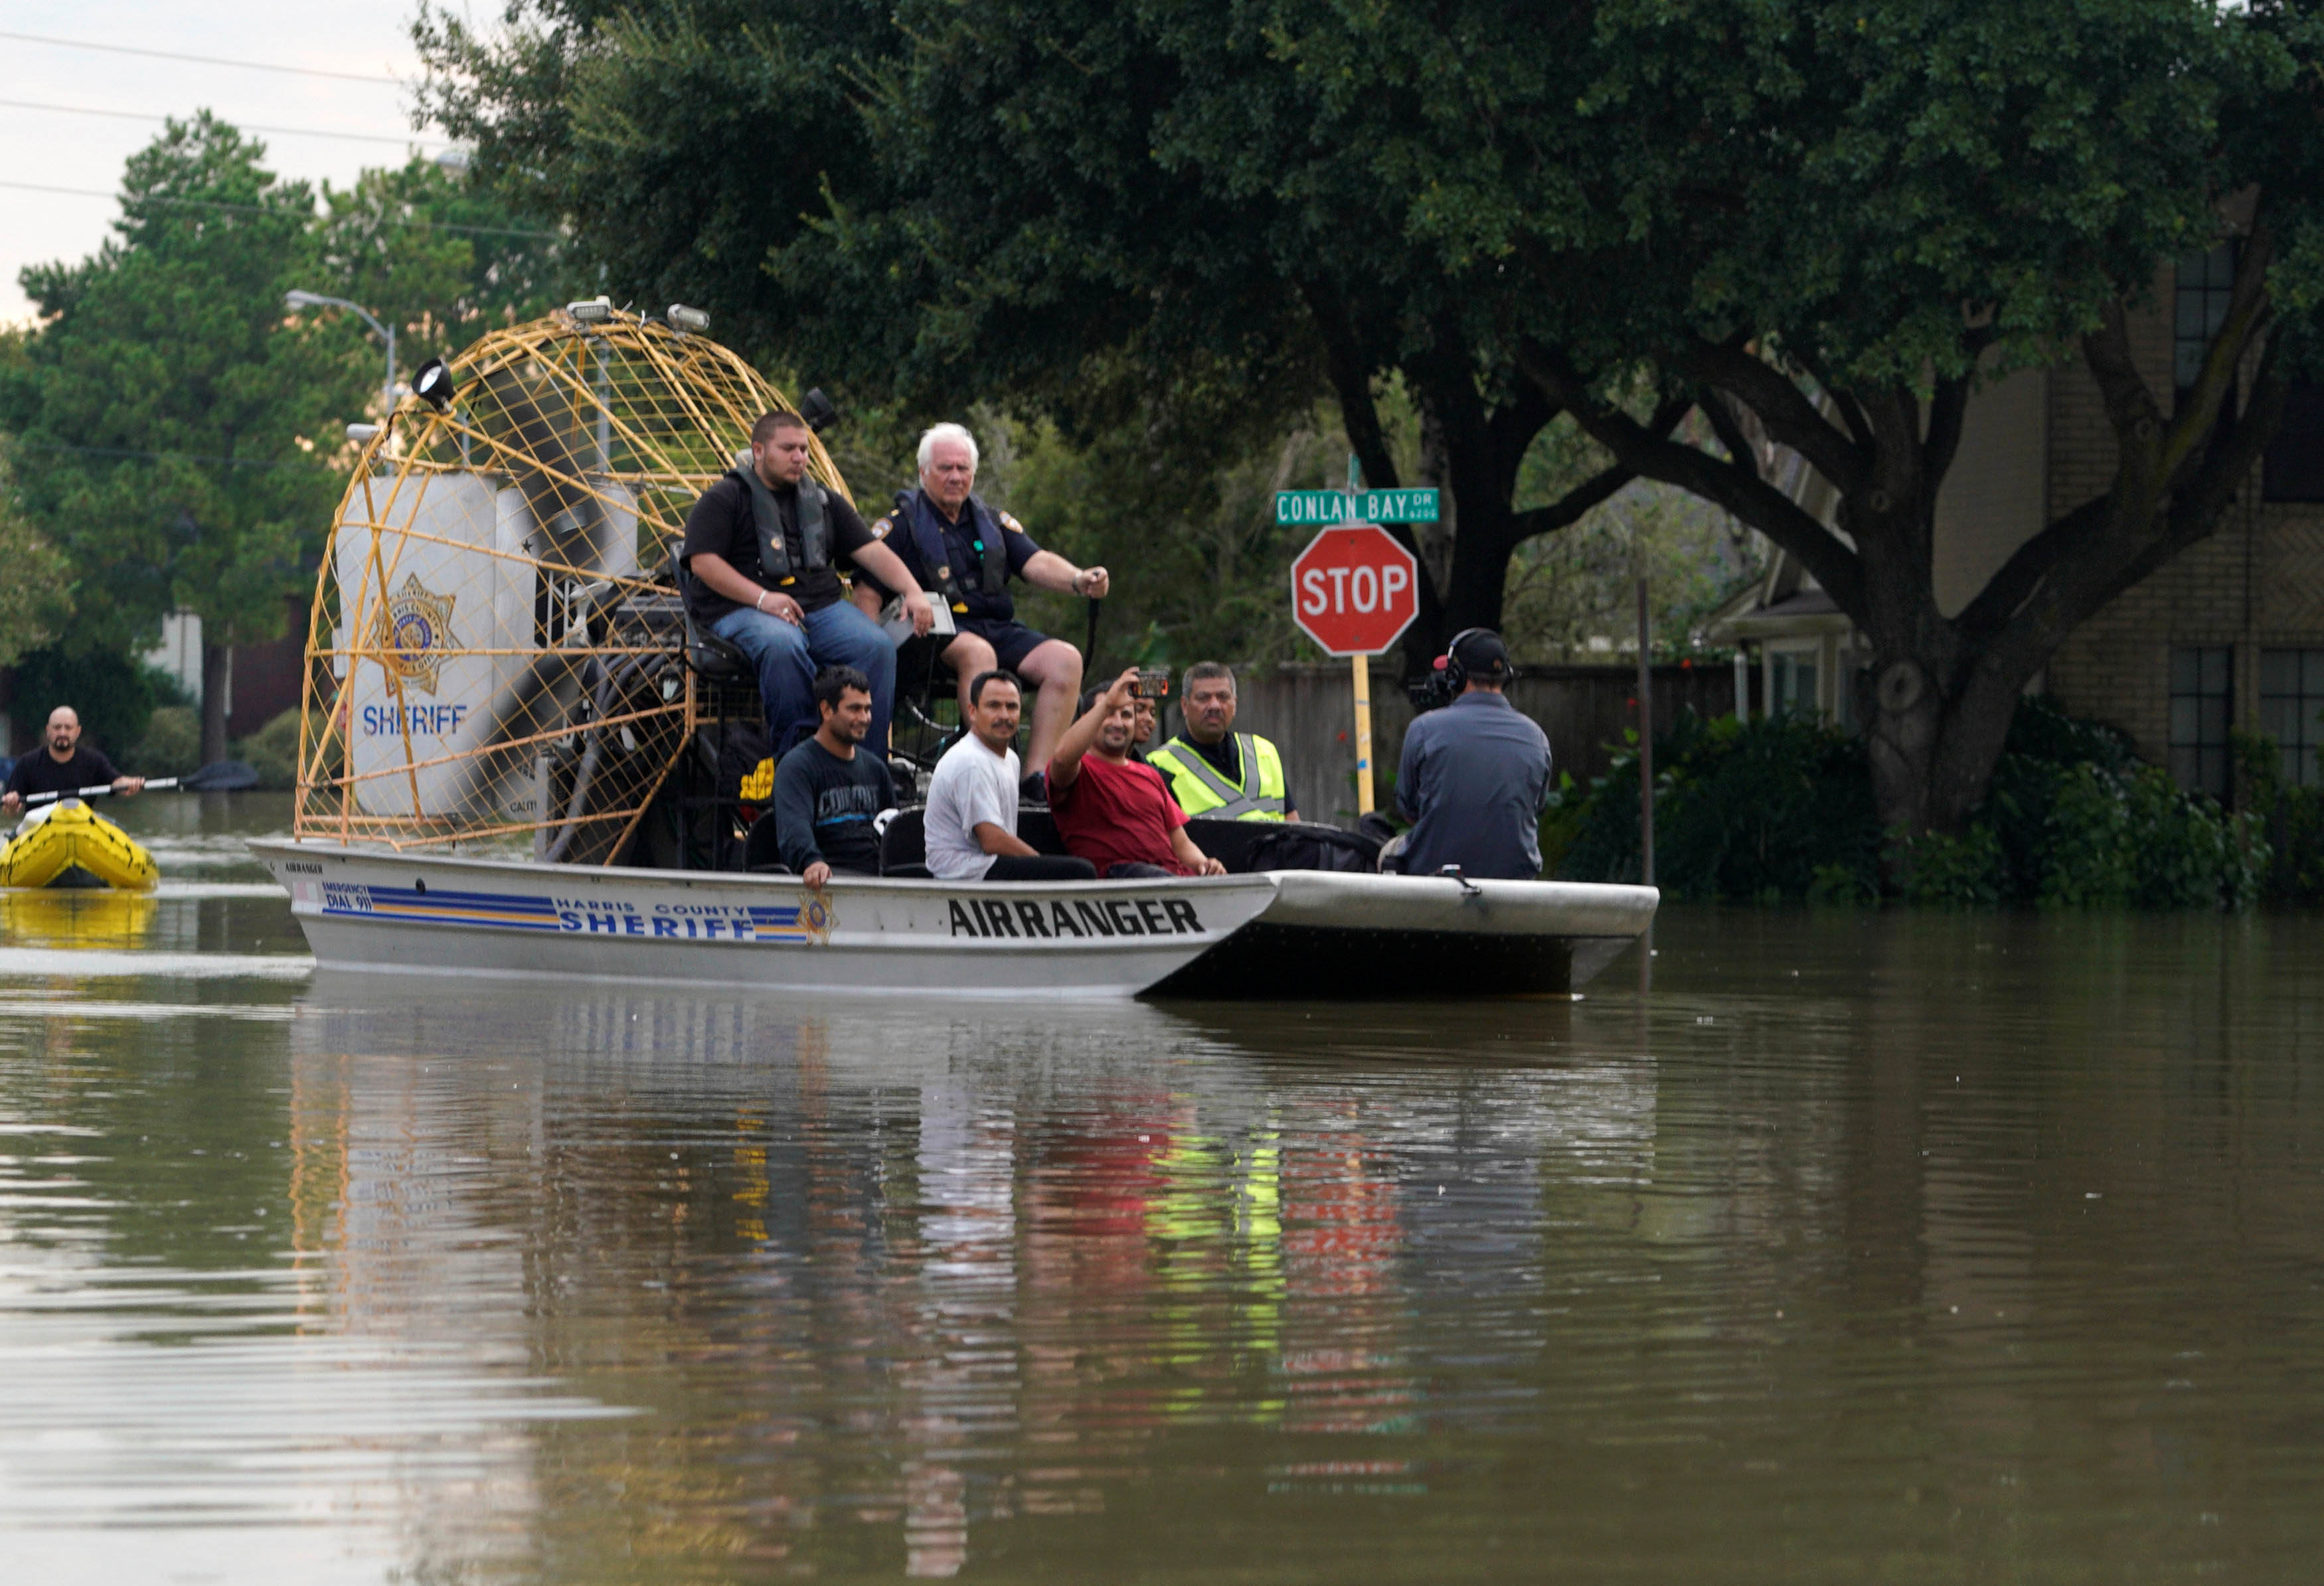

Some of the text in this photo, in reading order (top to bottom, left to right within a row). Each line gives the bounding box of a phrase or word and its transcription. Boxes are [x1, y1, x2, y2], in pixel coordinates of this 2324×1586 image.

[1277, 493, 1432, 521] CONLAN BAY DR
[1302, 565, 1408, 616] STOP
[363, 706, 467, 736] SHERIFF
[326, 894, 373, 912] DIAL 911
[557, 898, 746, 916] HARRIS COUNTY
[560, 911, 755, 940] SHERIFF
[948, 899, 1206, 937] AIRRANGER
